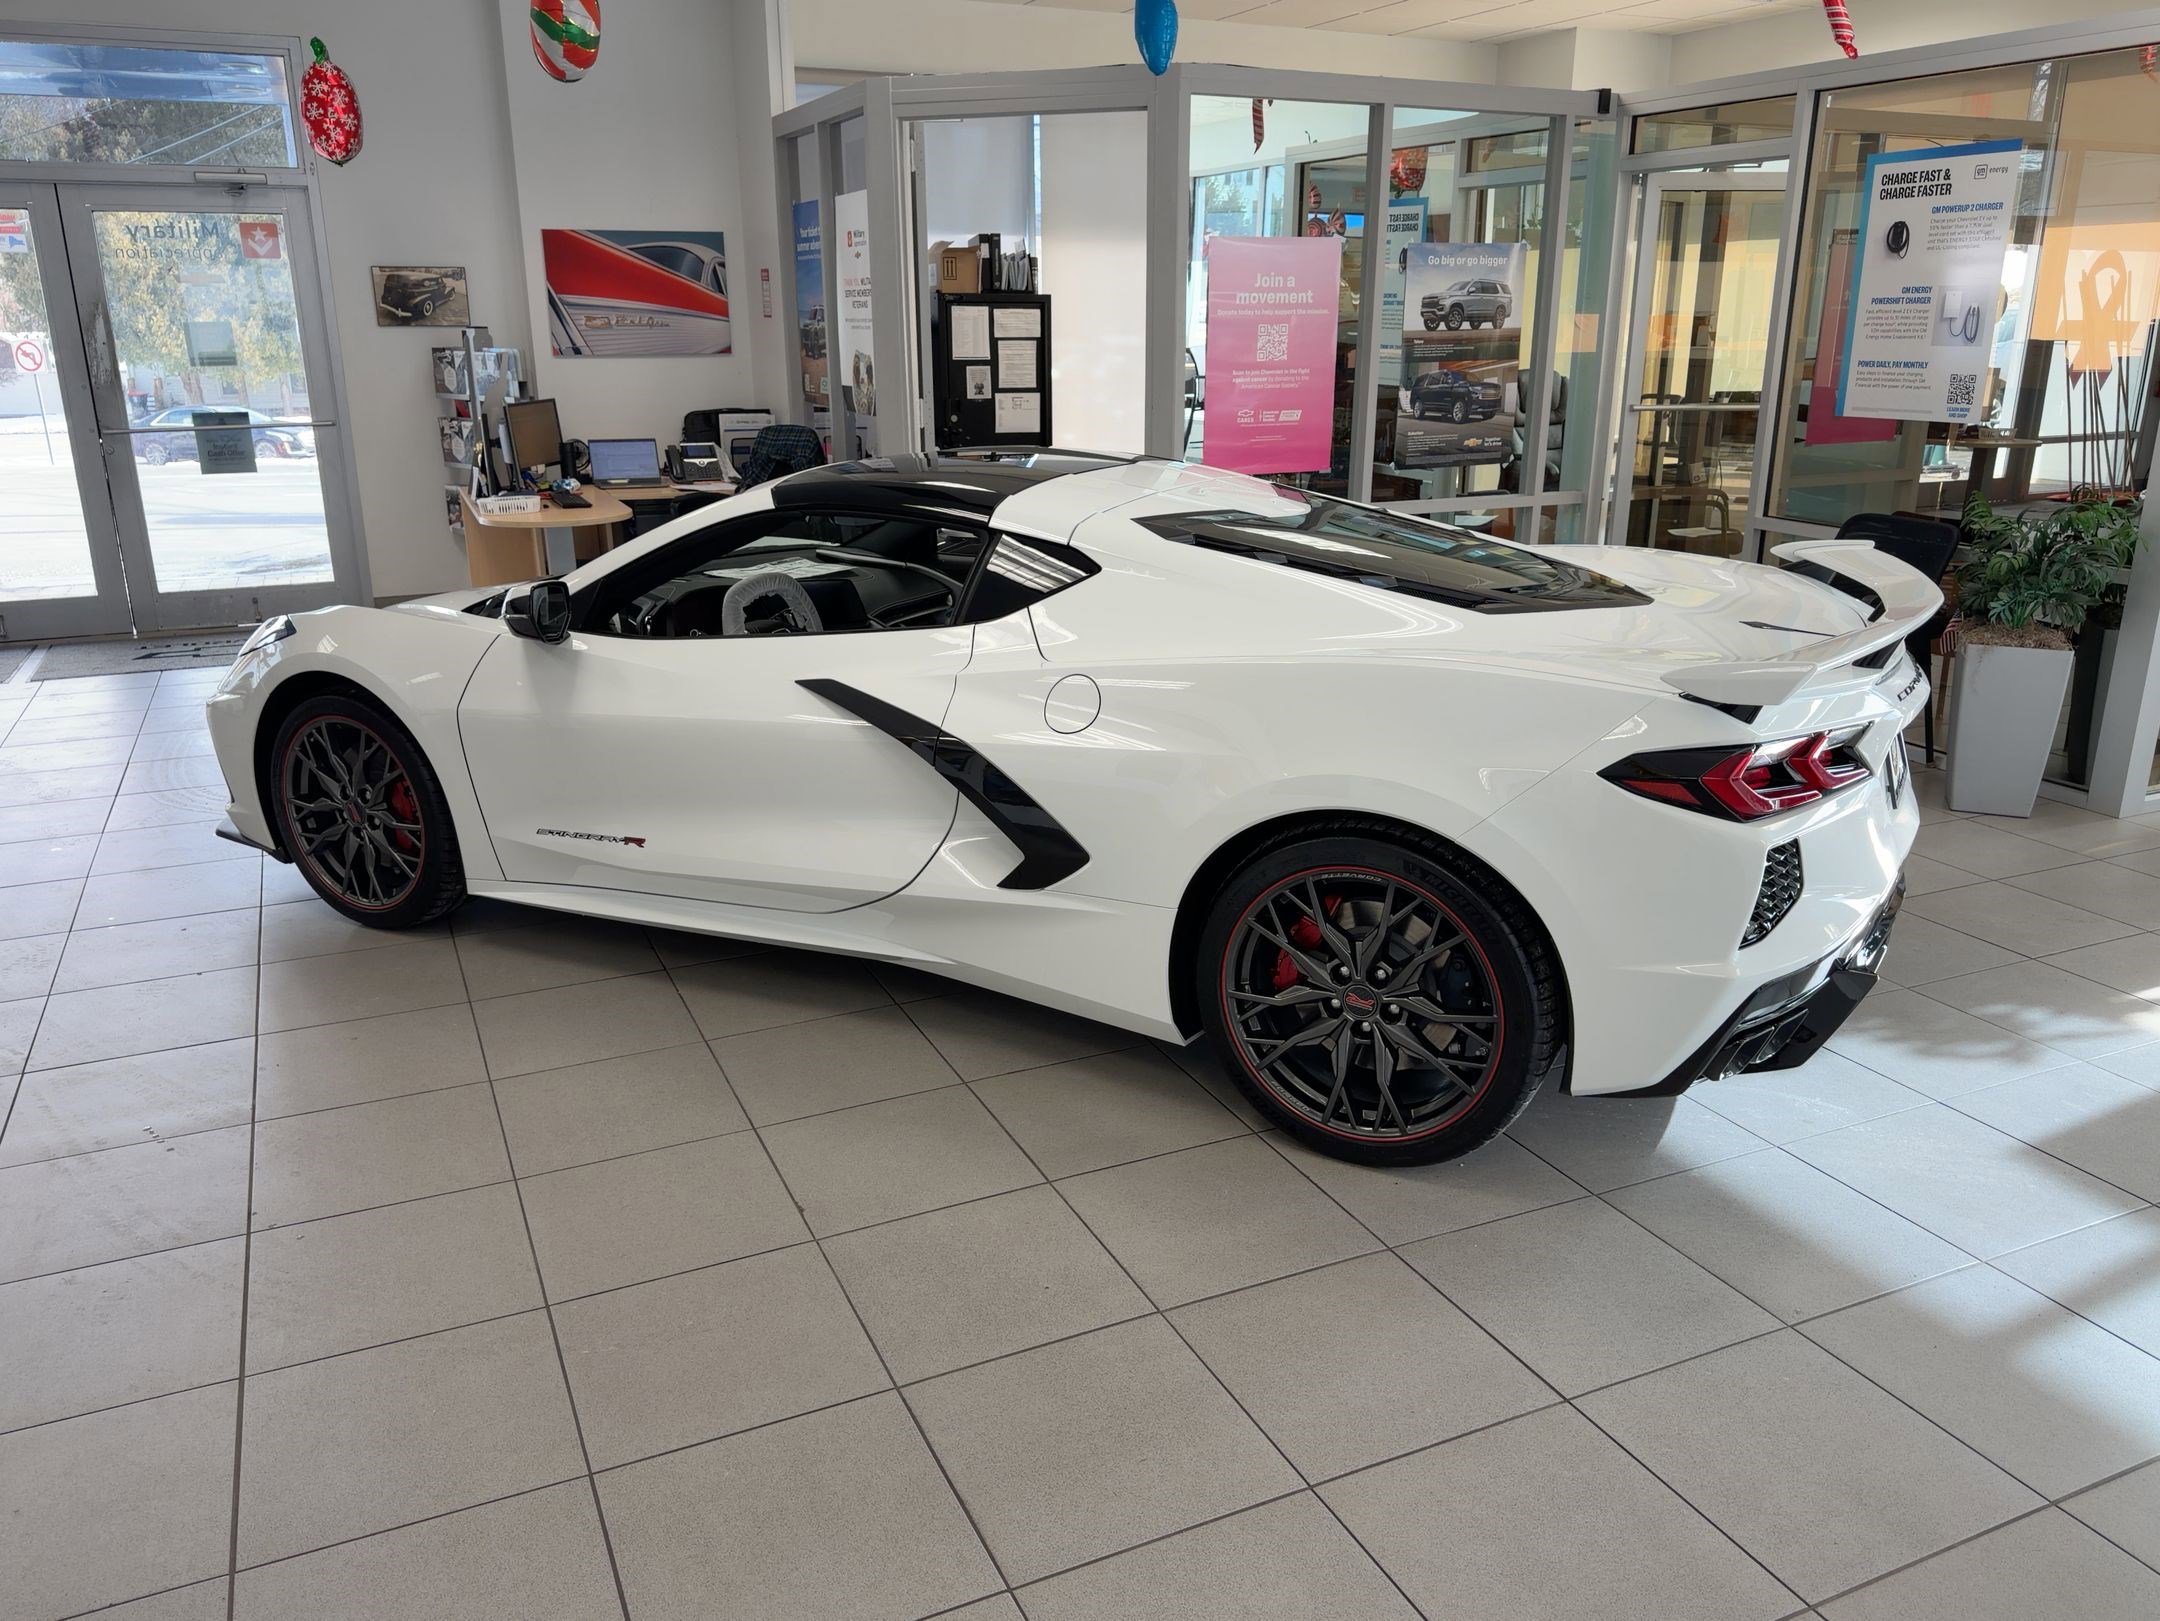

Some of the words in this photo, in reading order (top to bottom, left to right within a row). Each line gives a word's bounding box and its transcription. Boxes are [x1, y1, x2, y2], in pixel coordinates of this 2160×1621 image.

[1989, 166, 2008, 174] energy
[1882, 171, 1918, 186] CHARGE
[1919, 169, 1942, 182] FAST
[1944, 168, 1951, 180] &
[1880, 186, 1916, 200] CHARGE
[1917, 183, 1952, 197] FASTER
[1932, 206, 1941, 214] GM
[1942, 204, 1970, 213] POWERUP
[1975, 202, 2004, 211] CHARGER
[1428, 256, 1440, 264] Go
[1441, 255, 1454, 267] big
[1467, 257, 1478, 267] go
[1480, 255, 1508, 267] bigger
[1254, 272, 1283, 288] Join
[1287, 276, 1295, 287] a
[1902, 286, 1910, 294] GM
[1912, 286, 1932, 294] ENERGY
[1236, 290, 1313, 304] movement
[1871, 297, 1904, 305] POWERSHIFT
[1876, 361, 1891, 369] DAILY,
[1903, 361, 1928, 369] MONTHLY
